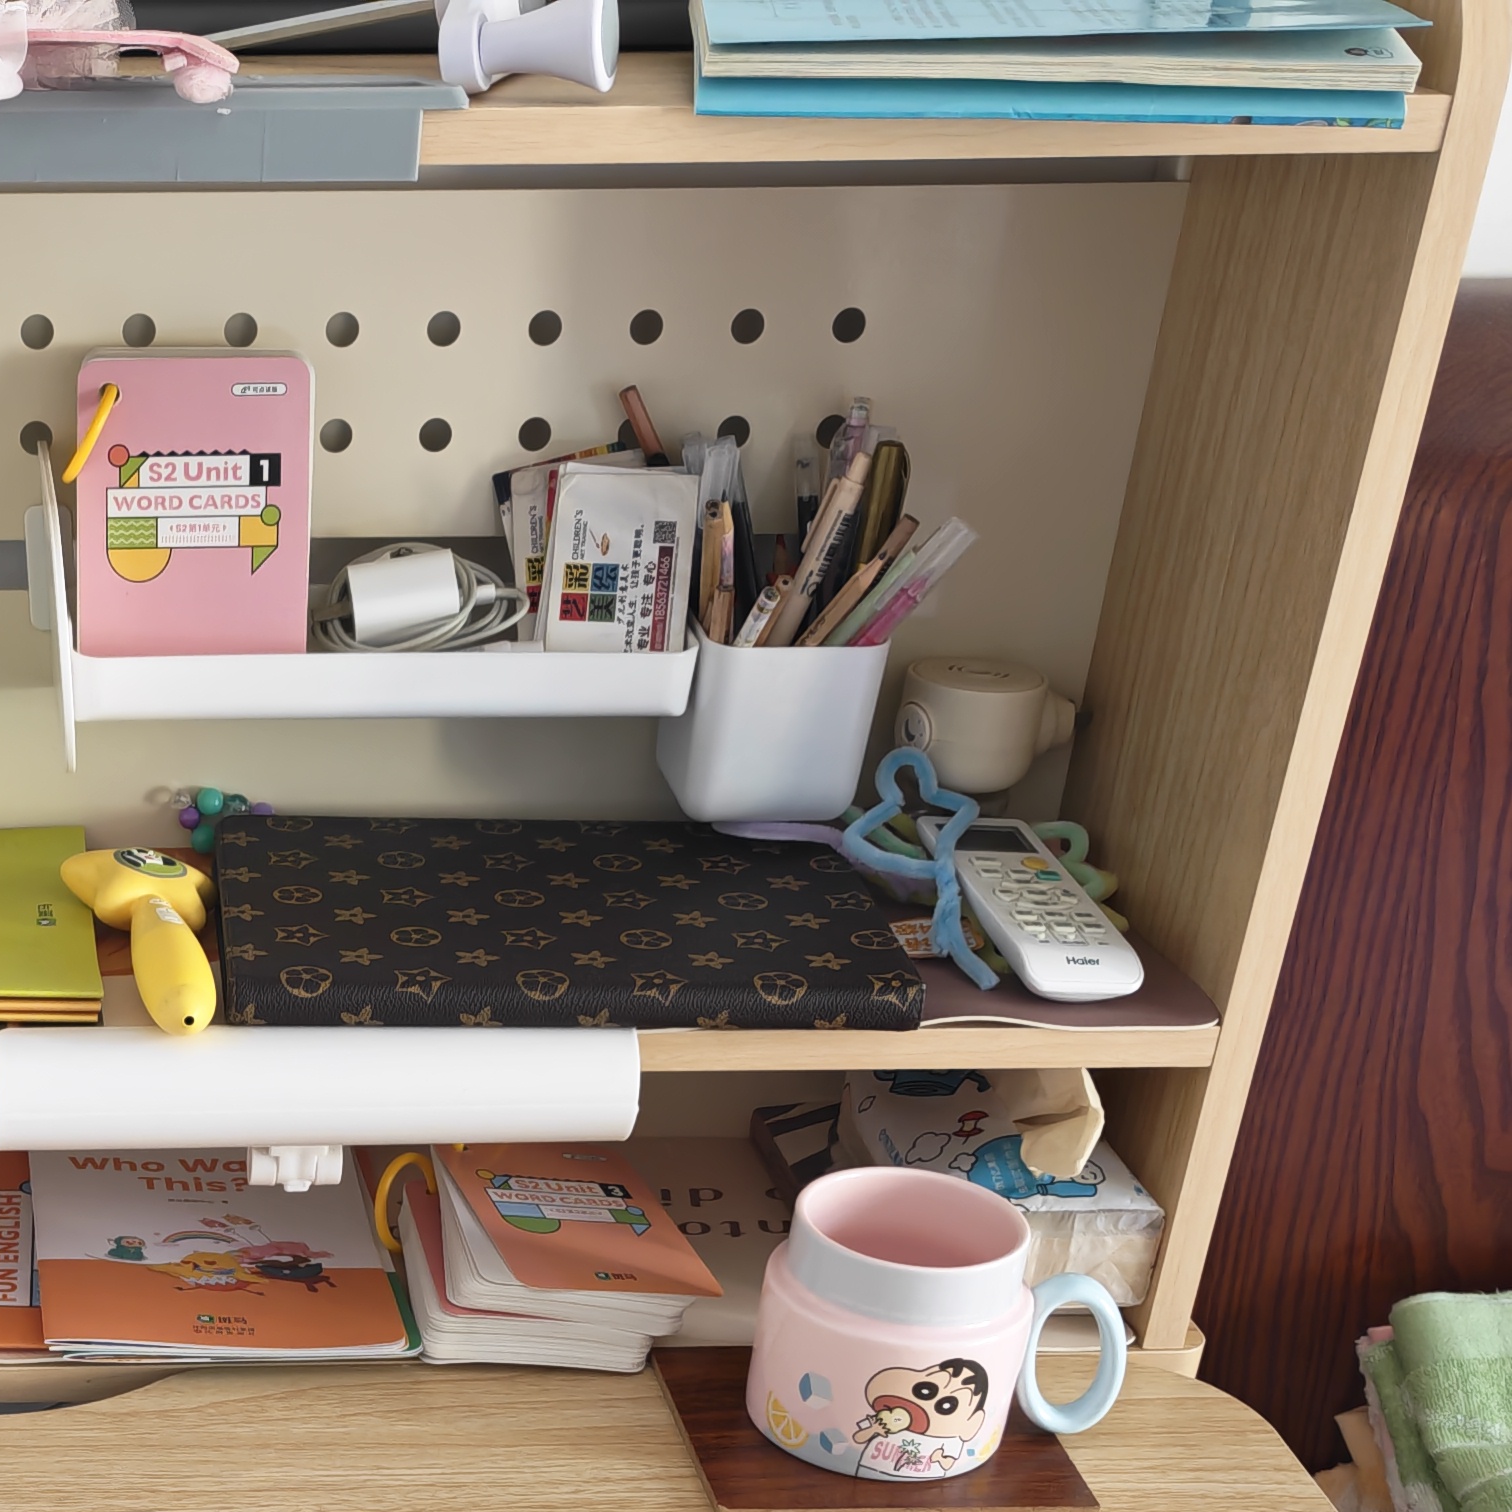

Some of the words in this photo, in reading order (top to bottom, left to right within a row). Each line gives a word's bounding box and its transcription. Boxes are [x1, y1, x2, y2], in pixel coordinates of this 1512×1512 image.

[149, 462, 177, 482] S2
[184, 461, 242, 481] Unit
[260, 459, 269, 481] 1
[113, 495, 183, 511] WORD
[189, 493, 261, 510] CARDS
[1066, 956, 1099, 965] Haier
[68, 1157, 165, 1172] Who
[137, 1177, 247, 1192] This?
[514, 1179, 543, 1190] S2
[544, 1182, 600, 1195] Unit
[607, 1185, 624, 1196] 3
[493, 1191, 555, 1204] WORD
[558, 1196, 623, 1208] CARDS
